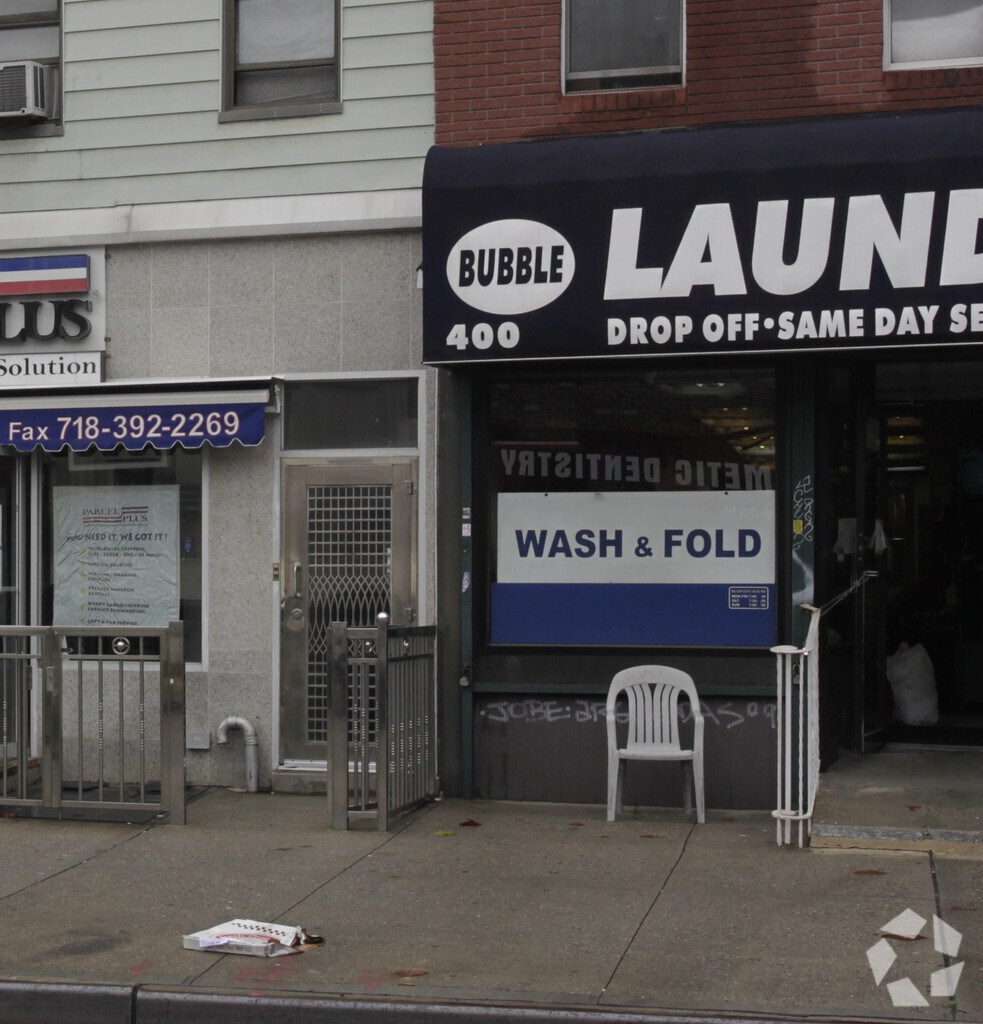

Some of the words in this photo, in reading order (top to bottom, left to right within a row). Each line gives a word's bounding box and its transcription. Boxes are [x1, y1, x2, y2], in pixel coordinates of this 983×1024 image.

[458, 245, 564, 287] BUBBLE
[446, 322, 520, 350] 400
[607, 314, 692, 346] DROP
[702, 312, 760, 342] OFF
[778, 308, 864, 339] SAME
[874, 305, 937, 336] DAY
[9, 421, 48, 441] Fax
[57, 411, 239, 439] 718-392-2269
[83, 507, 120, 516] PARCEL
[123, 515, 148, 523] PLUS
[135, 533, 152, 541] GOT
[515, 529, 622, 558] WASH
[634, 536, 653, 557] &
[664, 529, 761, 558] FOLD
